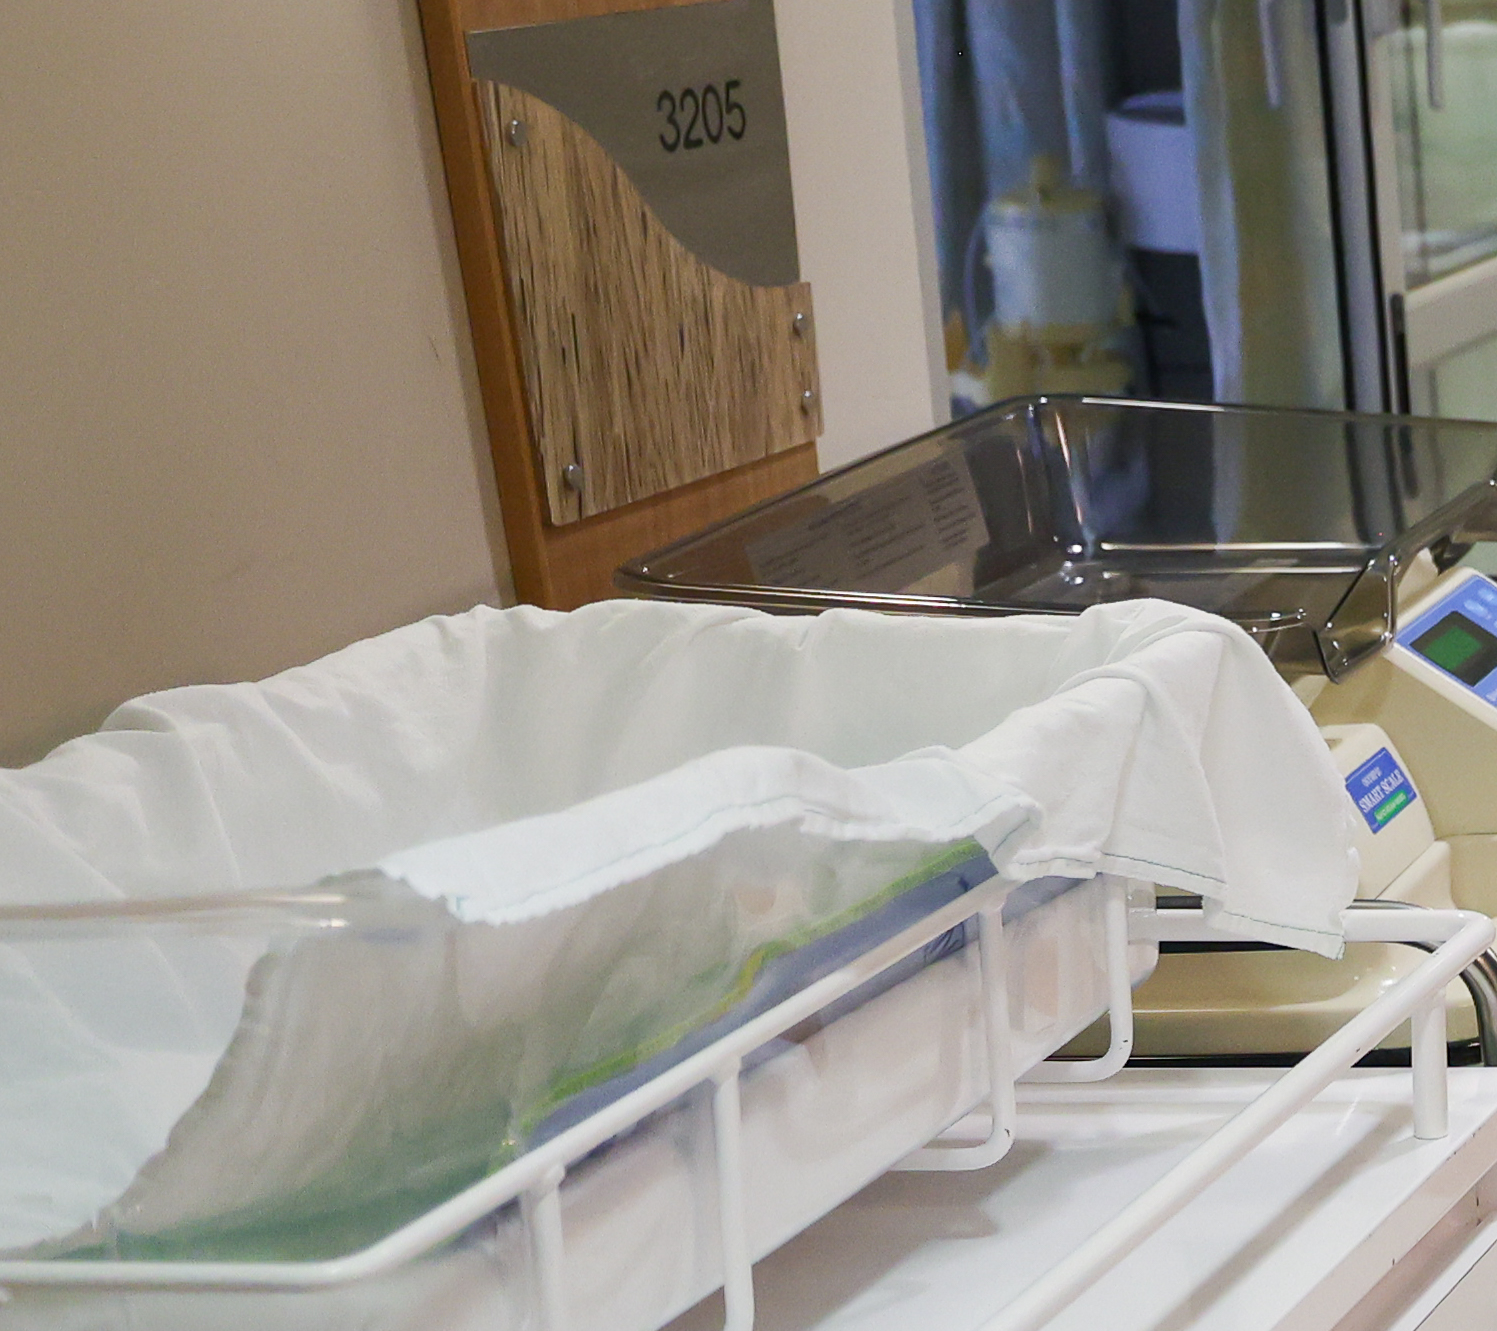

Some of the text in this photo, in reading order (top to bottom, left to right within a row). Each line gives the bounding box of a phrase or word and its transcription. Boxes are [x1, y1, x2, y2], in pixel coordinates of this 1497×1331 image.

[656, 79, 746, 153] 3205
[1358, 785, 1385, 814] SMART
[1379, 769, 1405, 795] SCALE
